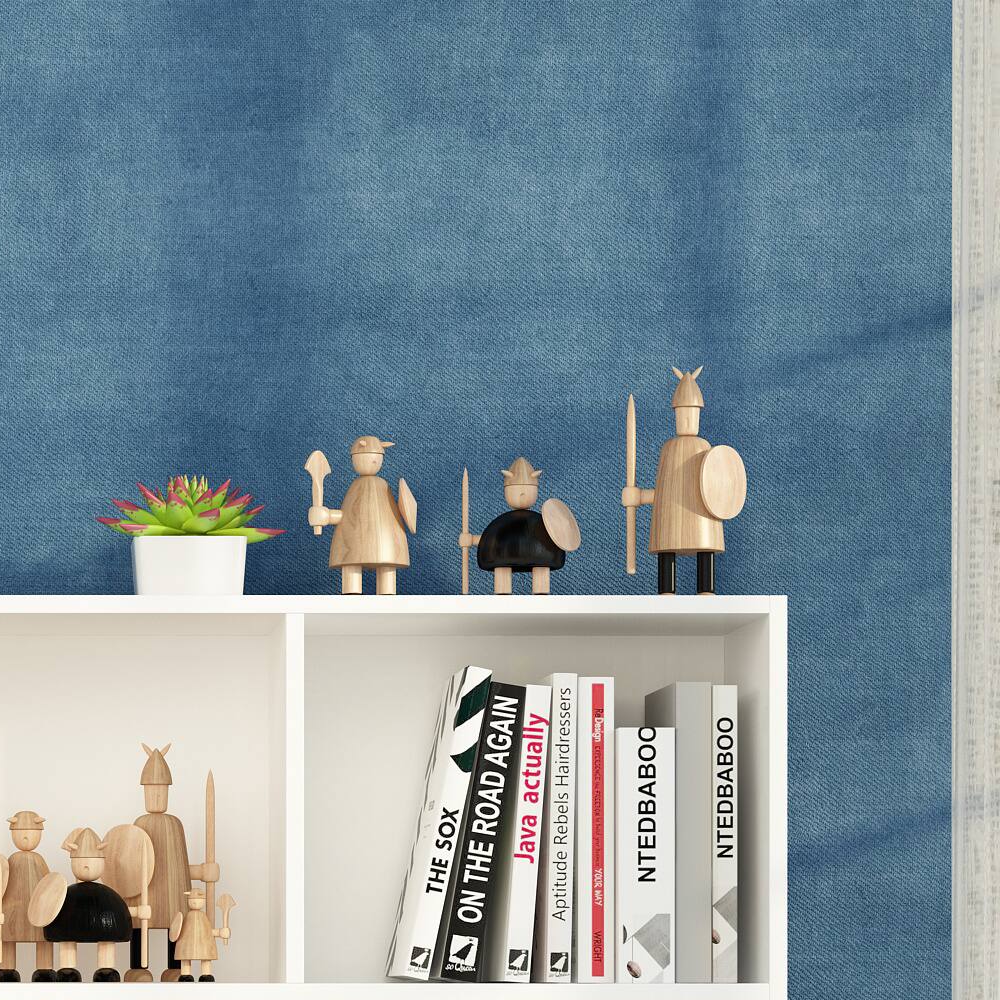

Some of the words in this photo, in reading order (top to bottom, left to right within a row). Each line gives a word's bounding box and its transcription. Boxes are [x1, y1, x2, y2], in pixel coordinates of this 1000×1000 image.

[490, 695, 519, 768] AGAIN
[554, 687, 571, 788] Hairdressers
[522, 713, 550, 804] actually
[471, 770, 506, 838] ROAD
[637, 727, 657, 882] NTEDBABOO
[717, 717, 734, 858] NTEDBABOO
[436, 807, 460, 851] SOX
[513, 814, 538, 864] Java
[554, 792, 569, 845] Rebels
[426, 857, 449, 894] THE
[463, 840, 495, 886] THE
[552, 850, 568, 921] Aptitude
[594, 868, 603, 888] YOUR
[456, 890, 486, 924] ON
[594, 889, 603, 906] WAY
[593, 931, 602, 962] WRIGHT
